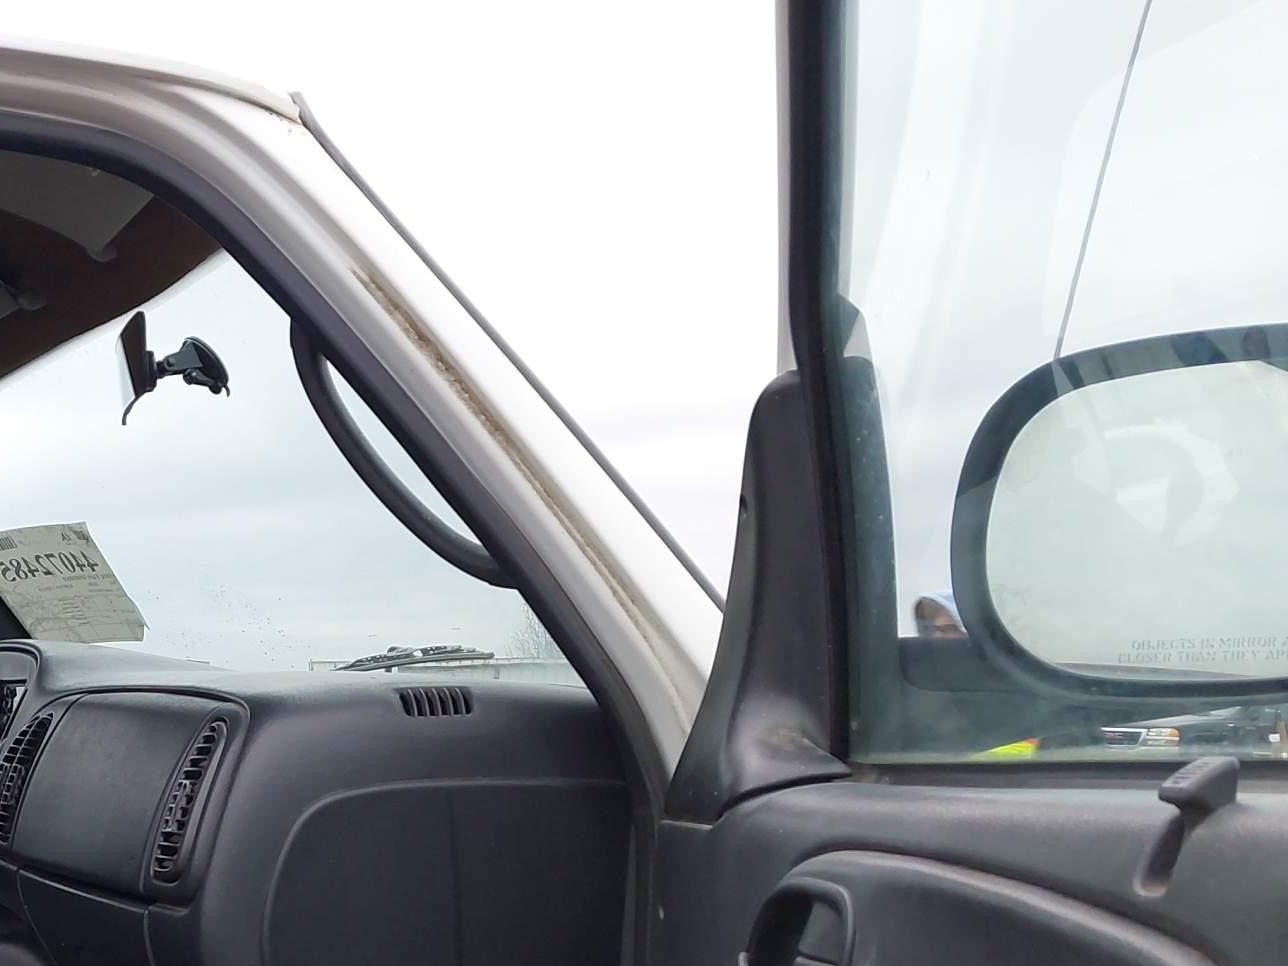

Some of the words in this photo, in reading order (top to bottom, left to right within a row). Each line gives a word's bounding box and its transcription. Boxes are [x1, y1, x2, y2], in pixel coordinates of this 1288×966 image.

[1131, 638, 1195, 651] OBJECTS
[1200, 638, 1215, 649] IN
[1219, 636, 1278, 649] MIRROR
[1117, 650, 1174, 664] CLOSER
[1178, 650, 1217, 663] THAN
[1223, 649, 1258, 662] THEY
